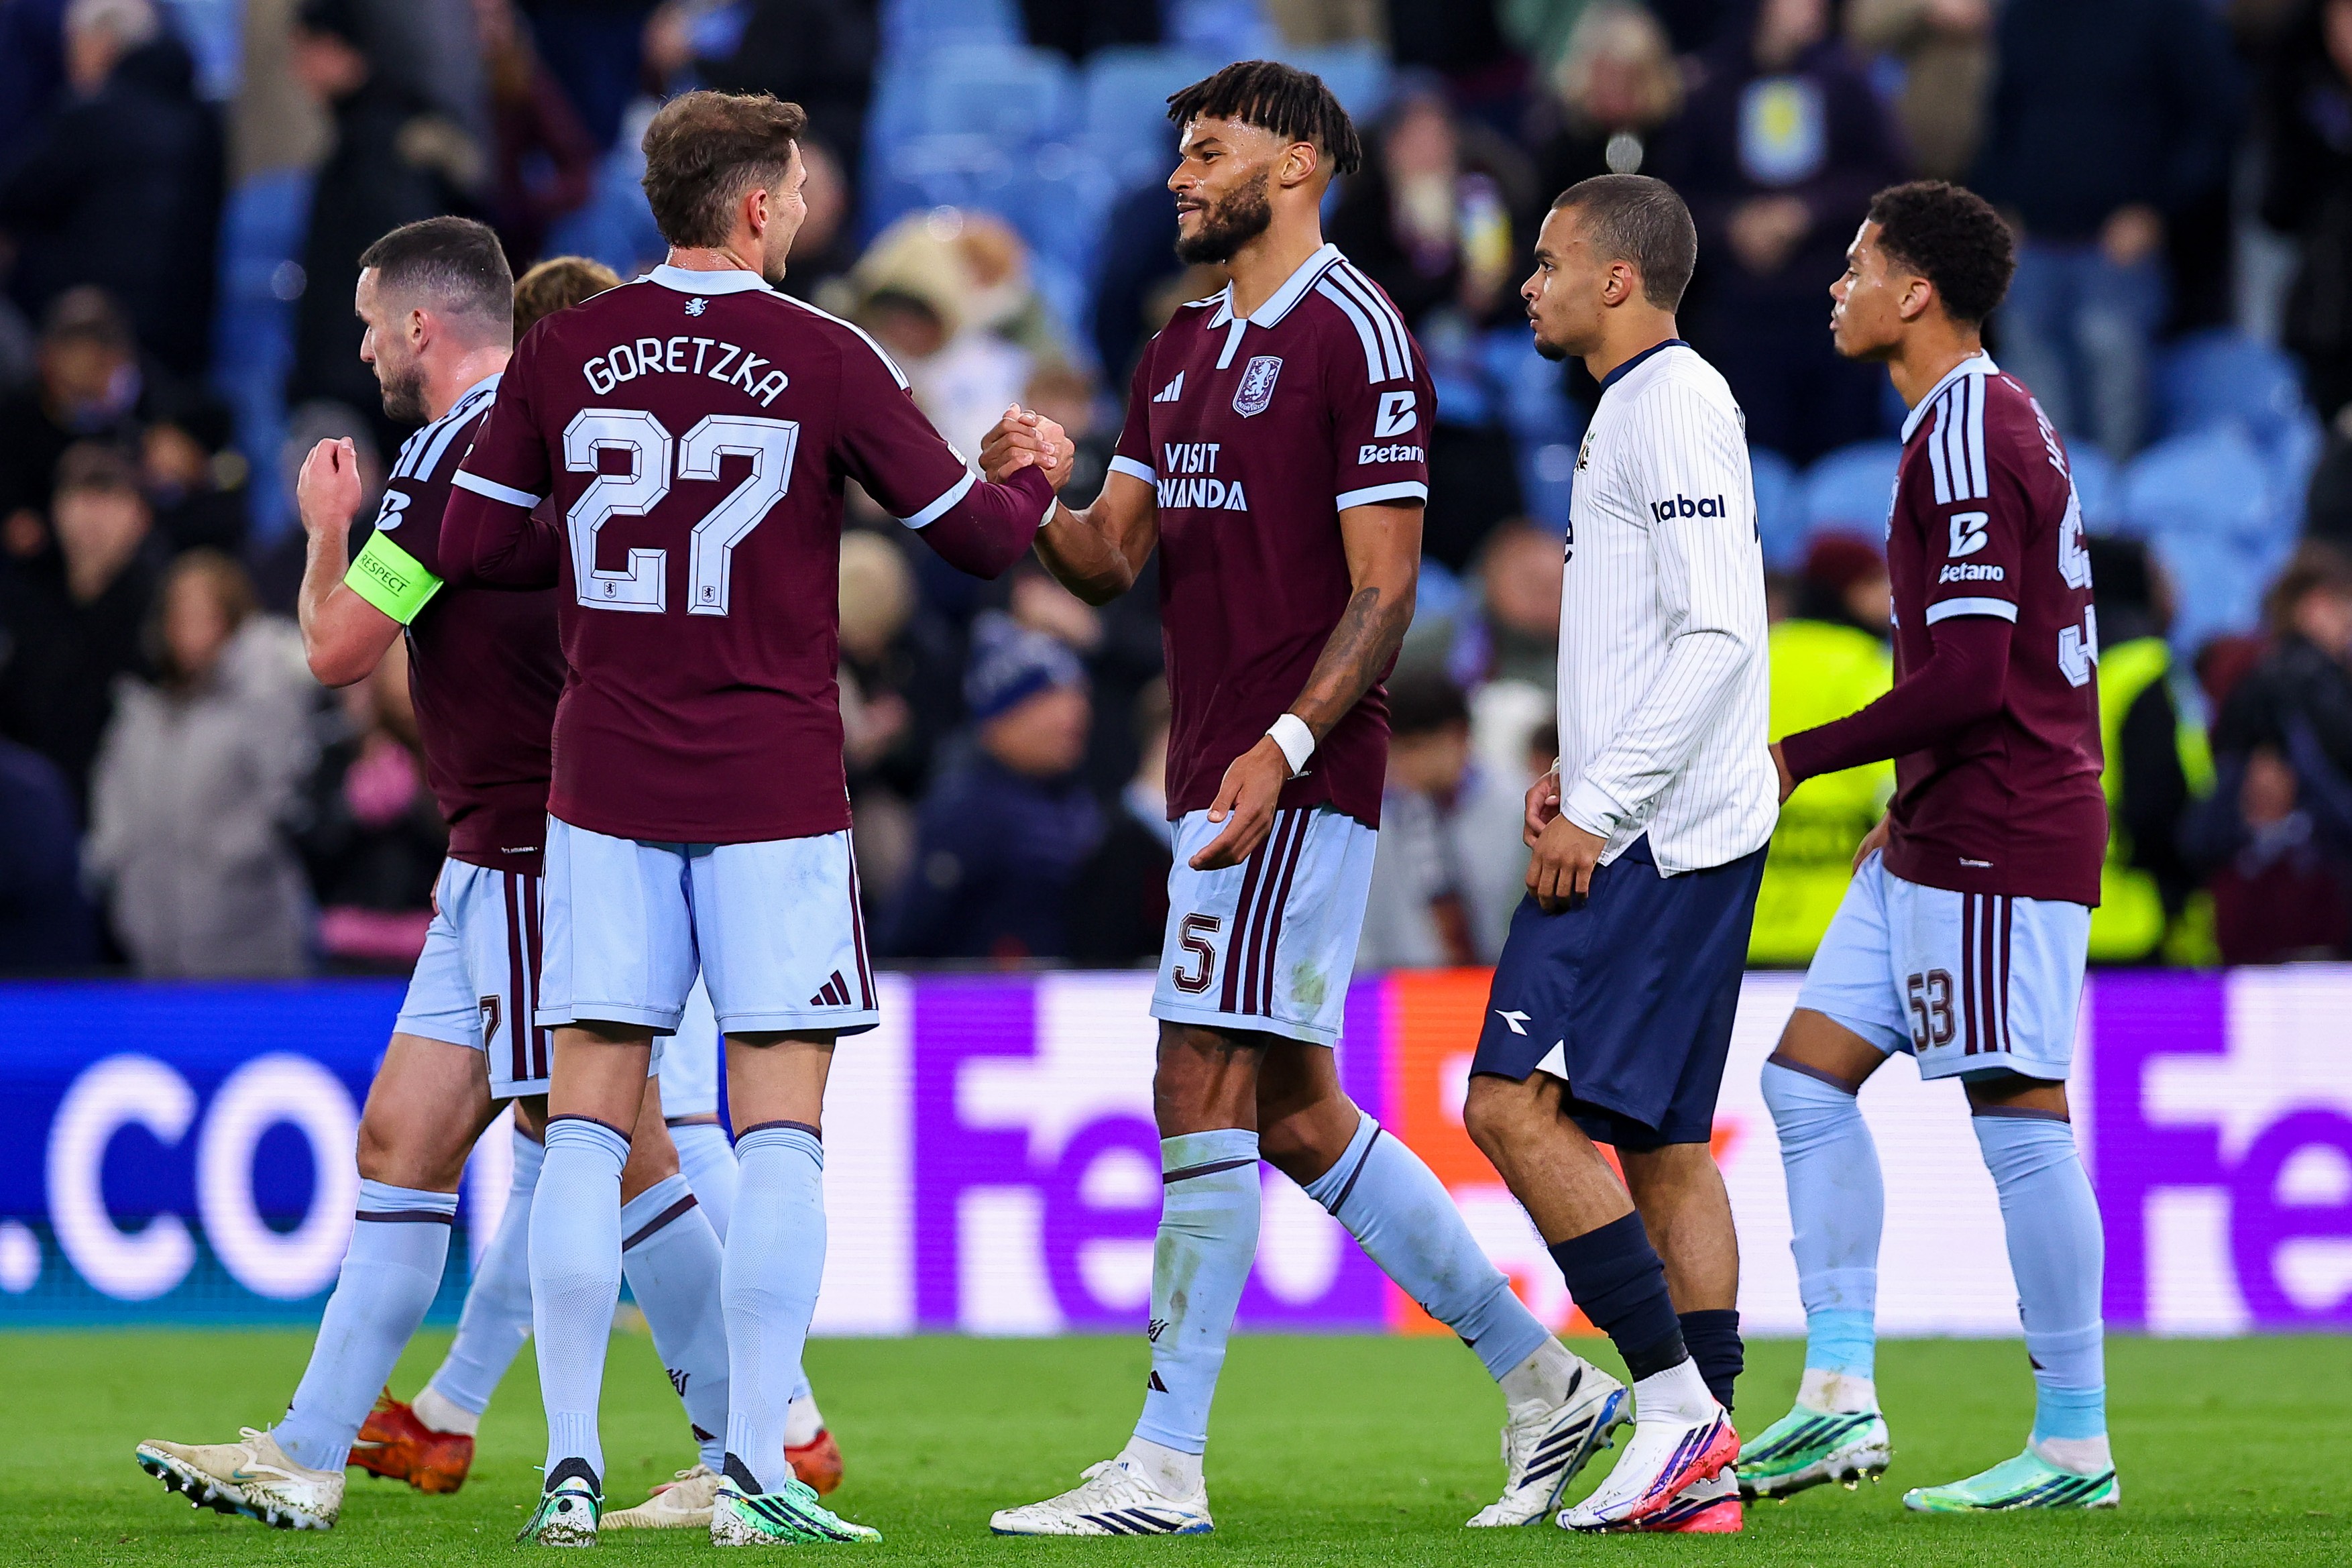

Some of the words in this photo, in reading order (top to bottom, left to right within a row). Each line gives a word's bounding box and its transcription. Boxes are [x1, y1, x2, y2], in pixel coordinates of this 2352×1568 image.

[583, 336, 789, 408] GORETZKA
[1165, 443, 1220, 473] VISIT
[1358, 444, 1424, 464] Betano
[563, 407, 800, 618] 27
[1156, 478, 1248, 511] RWANDA
[360, 555, 407, 592] RESPECT
[1938, 562, 2004, 585] Betano
[1173, 912, 1221, 995] 5
[480, 994, 501, 1074] 7
[1907, 968, 1956, 1052] 53
